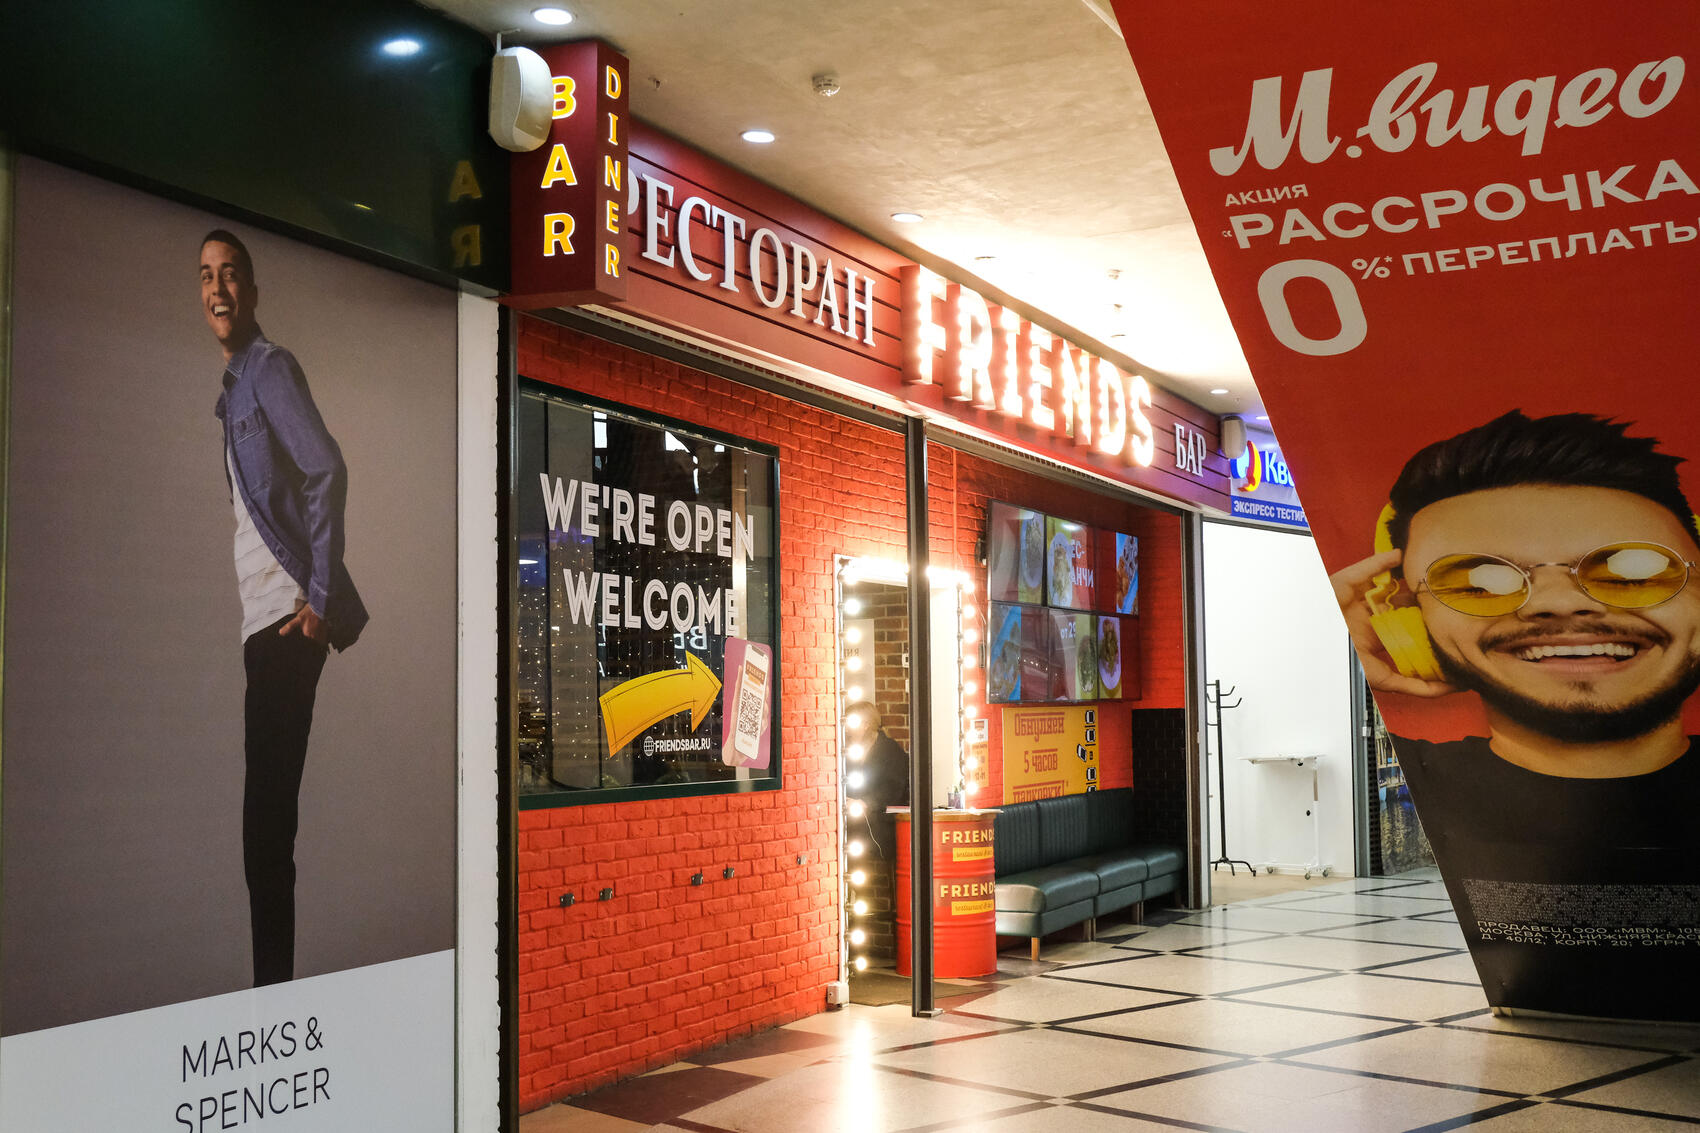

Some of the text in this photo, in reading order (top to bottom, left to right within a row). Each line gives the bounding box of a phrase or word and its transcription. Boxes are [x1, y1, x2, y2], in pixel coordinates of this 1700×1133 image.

[541, 76, 578, 257] BAR
[605, 65, 622, 278] DINER
[1225, 184, 1309, 207] АКЦИЯ
[915, 264, 1154, 467] FRIENDS
[1174, 423, 1207, 478] БАР
[1264, 450, 1295, 487] Кв
[540, 473, 754, 561] WE'RE OPEN
[1234, 501, 1309, 522] ЭКСПРЕСС ТЕСТИР
[563, 568, 740, 637] WELCOME
[654, 738, 711, 753] FRIENDSBAR.RU
[942, 829, 994, 844] FRIEND
[940, 881, 995, 898] FRIEND
[1655, 933, 1700, 941] КРАС
[182, 1016, 323, 1083] MARKS &
[175, 1067, 331, 1133] SPENCER
